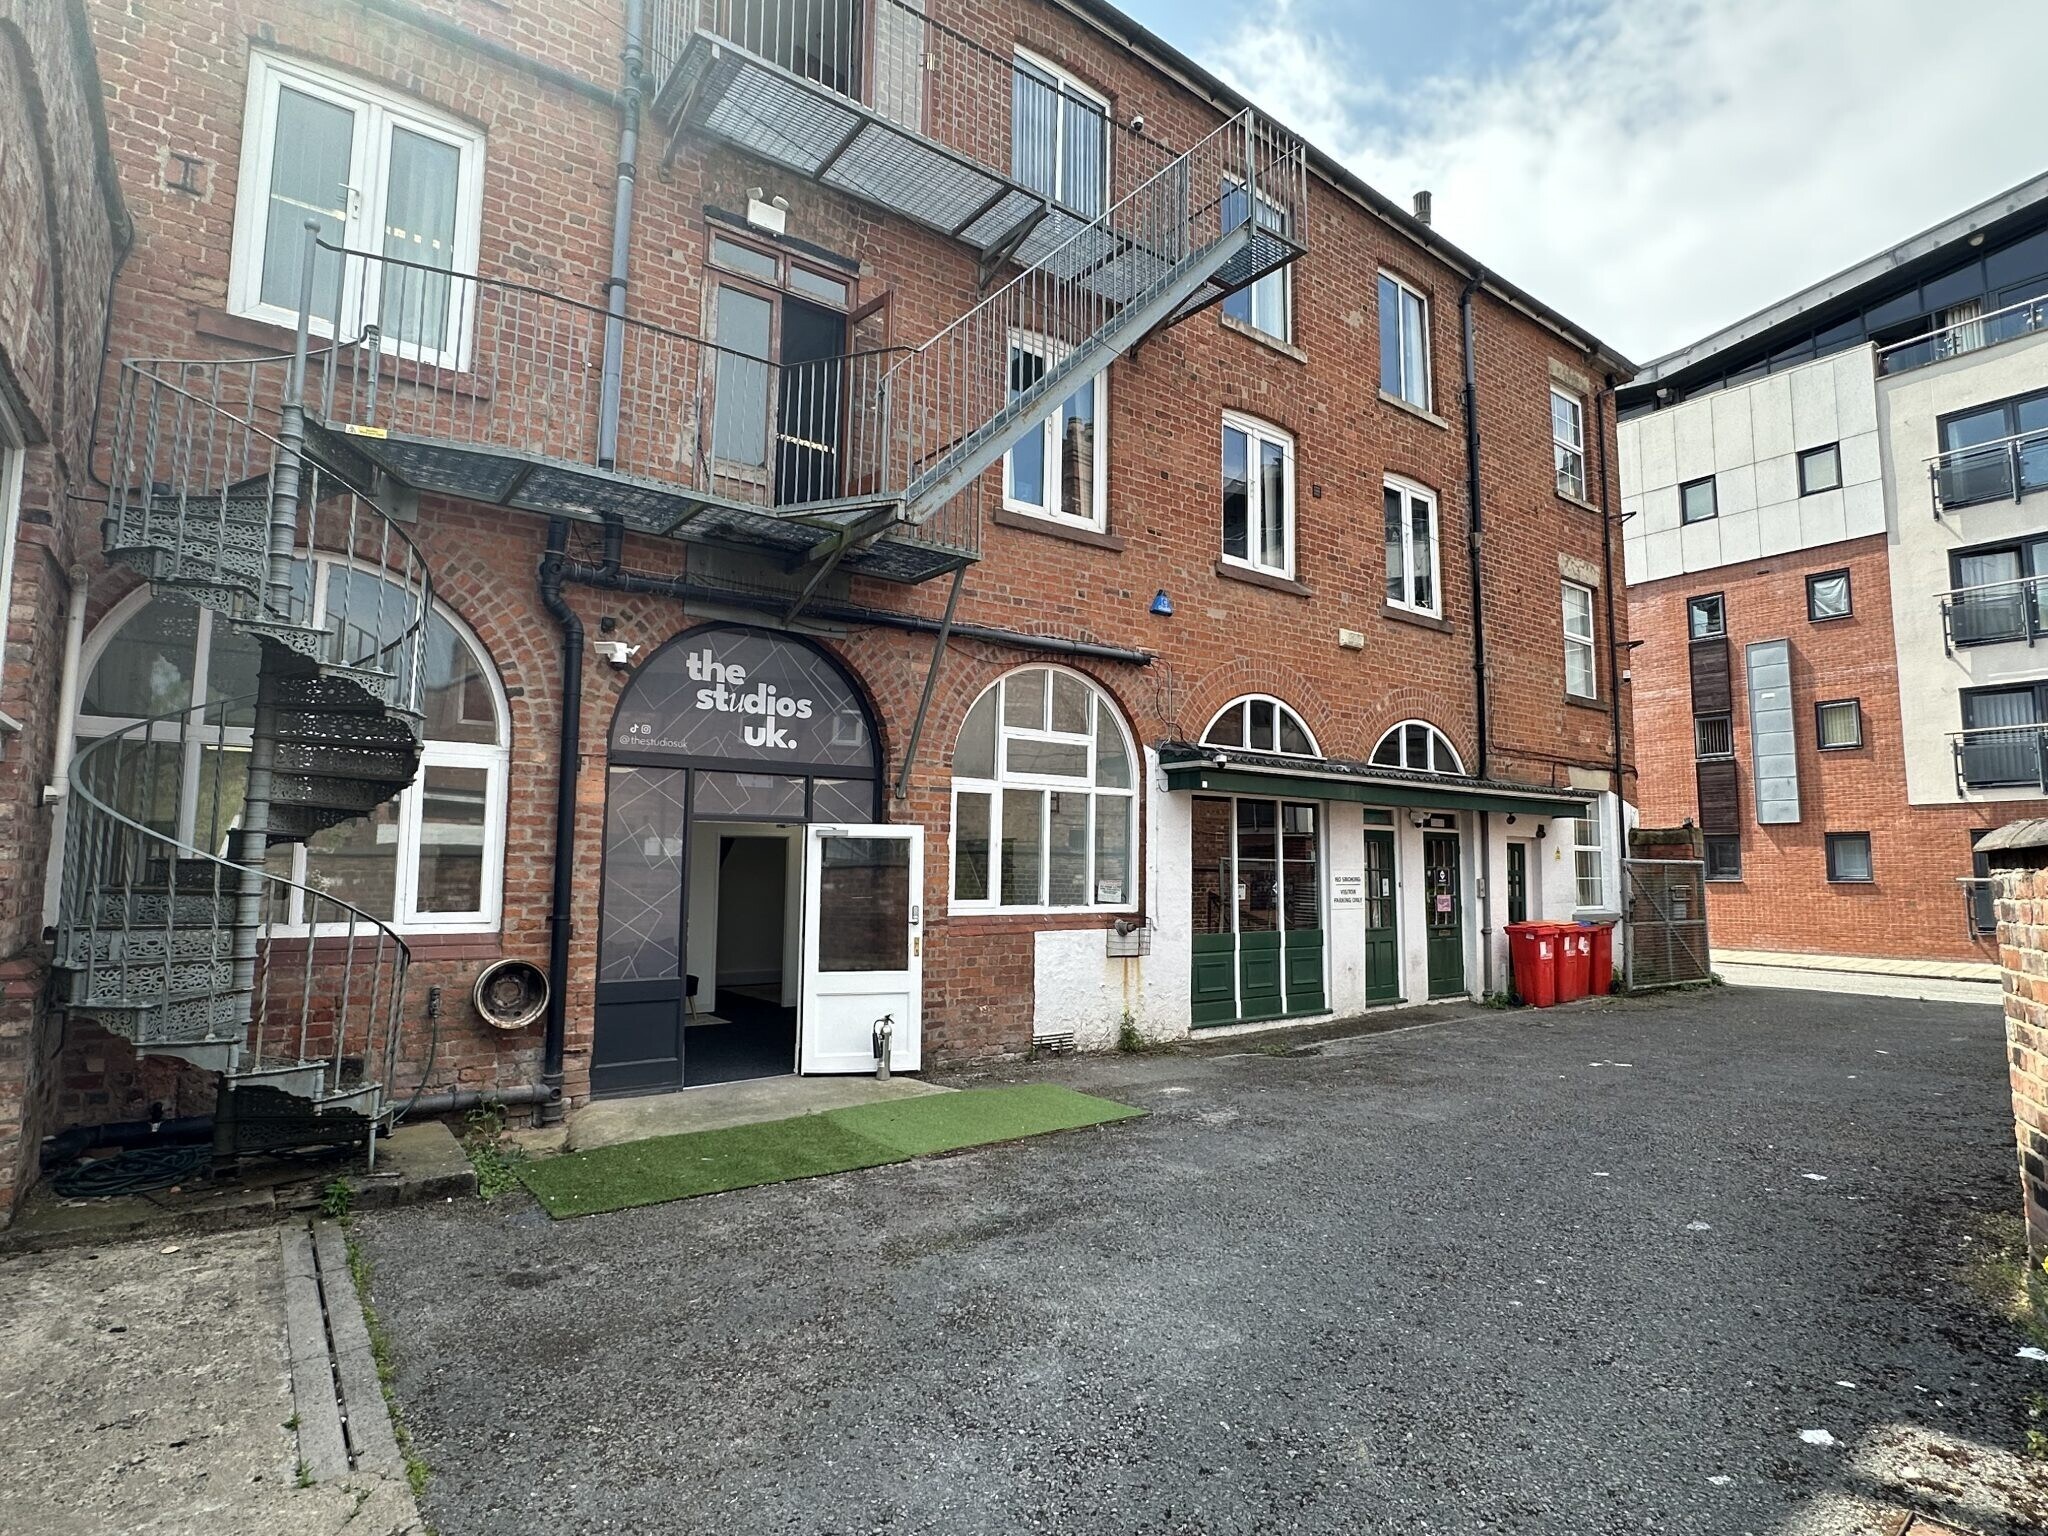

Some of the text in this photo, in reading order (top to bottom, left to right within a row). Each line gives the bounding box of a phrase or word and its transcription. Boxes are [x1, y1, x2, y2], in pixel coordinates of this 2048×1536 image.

[686, 649, 746, 685] the
[695, 683, 813, 719] studios
[619, 735, 688, 748] @thestudiosuk
[743, 715, 798, 750] uk.
